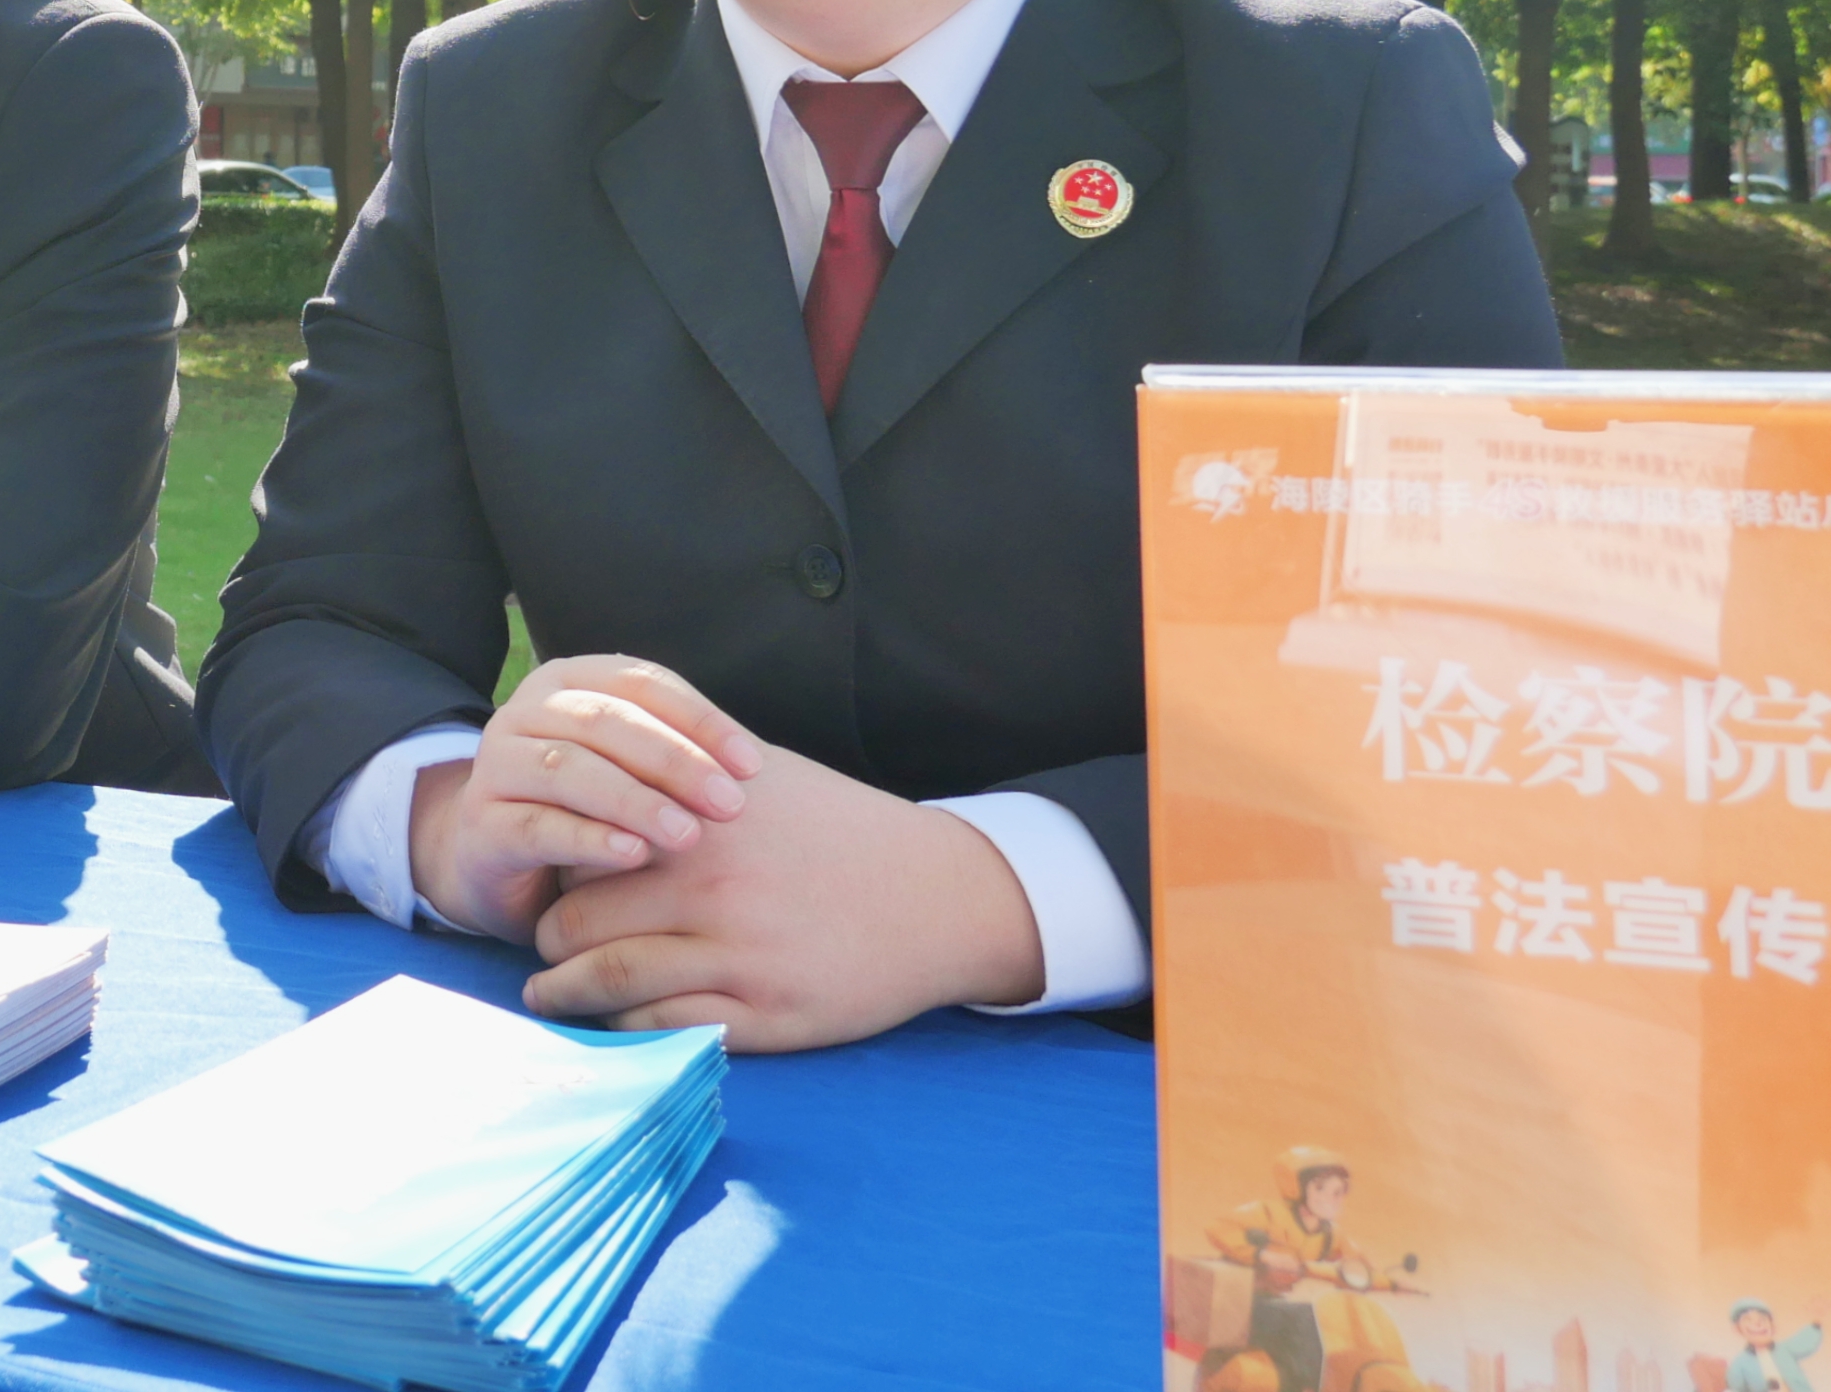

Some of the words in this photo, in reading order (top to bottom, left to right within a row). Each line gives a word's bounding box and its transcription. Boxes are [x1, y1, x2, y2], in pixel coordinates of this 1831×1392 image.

[1360, 656, 1831, 810] 检察院
[1381, 857, 1829, 986] 普法宣传
